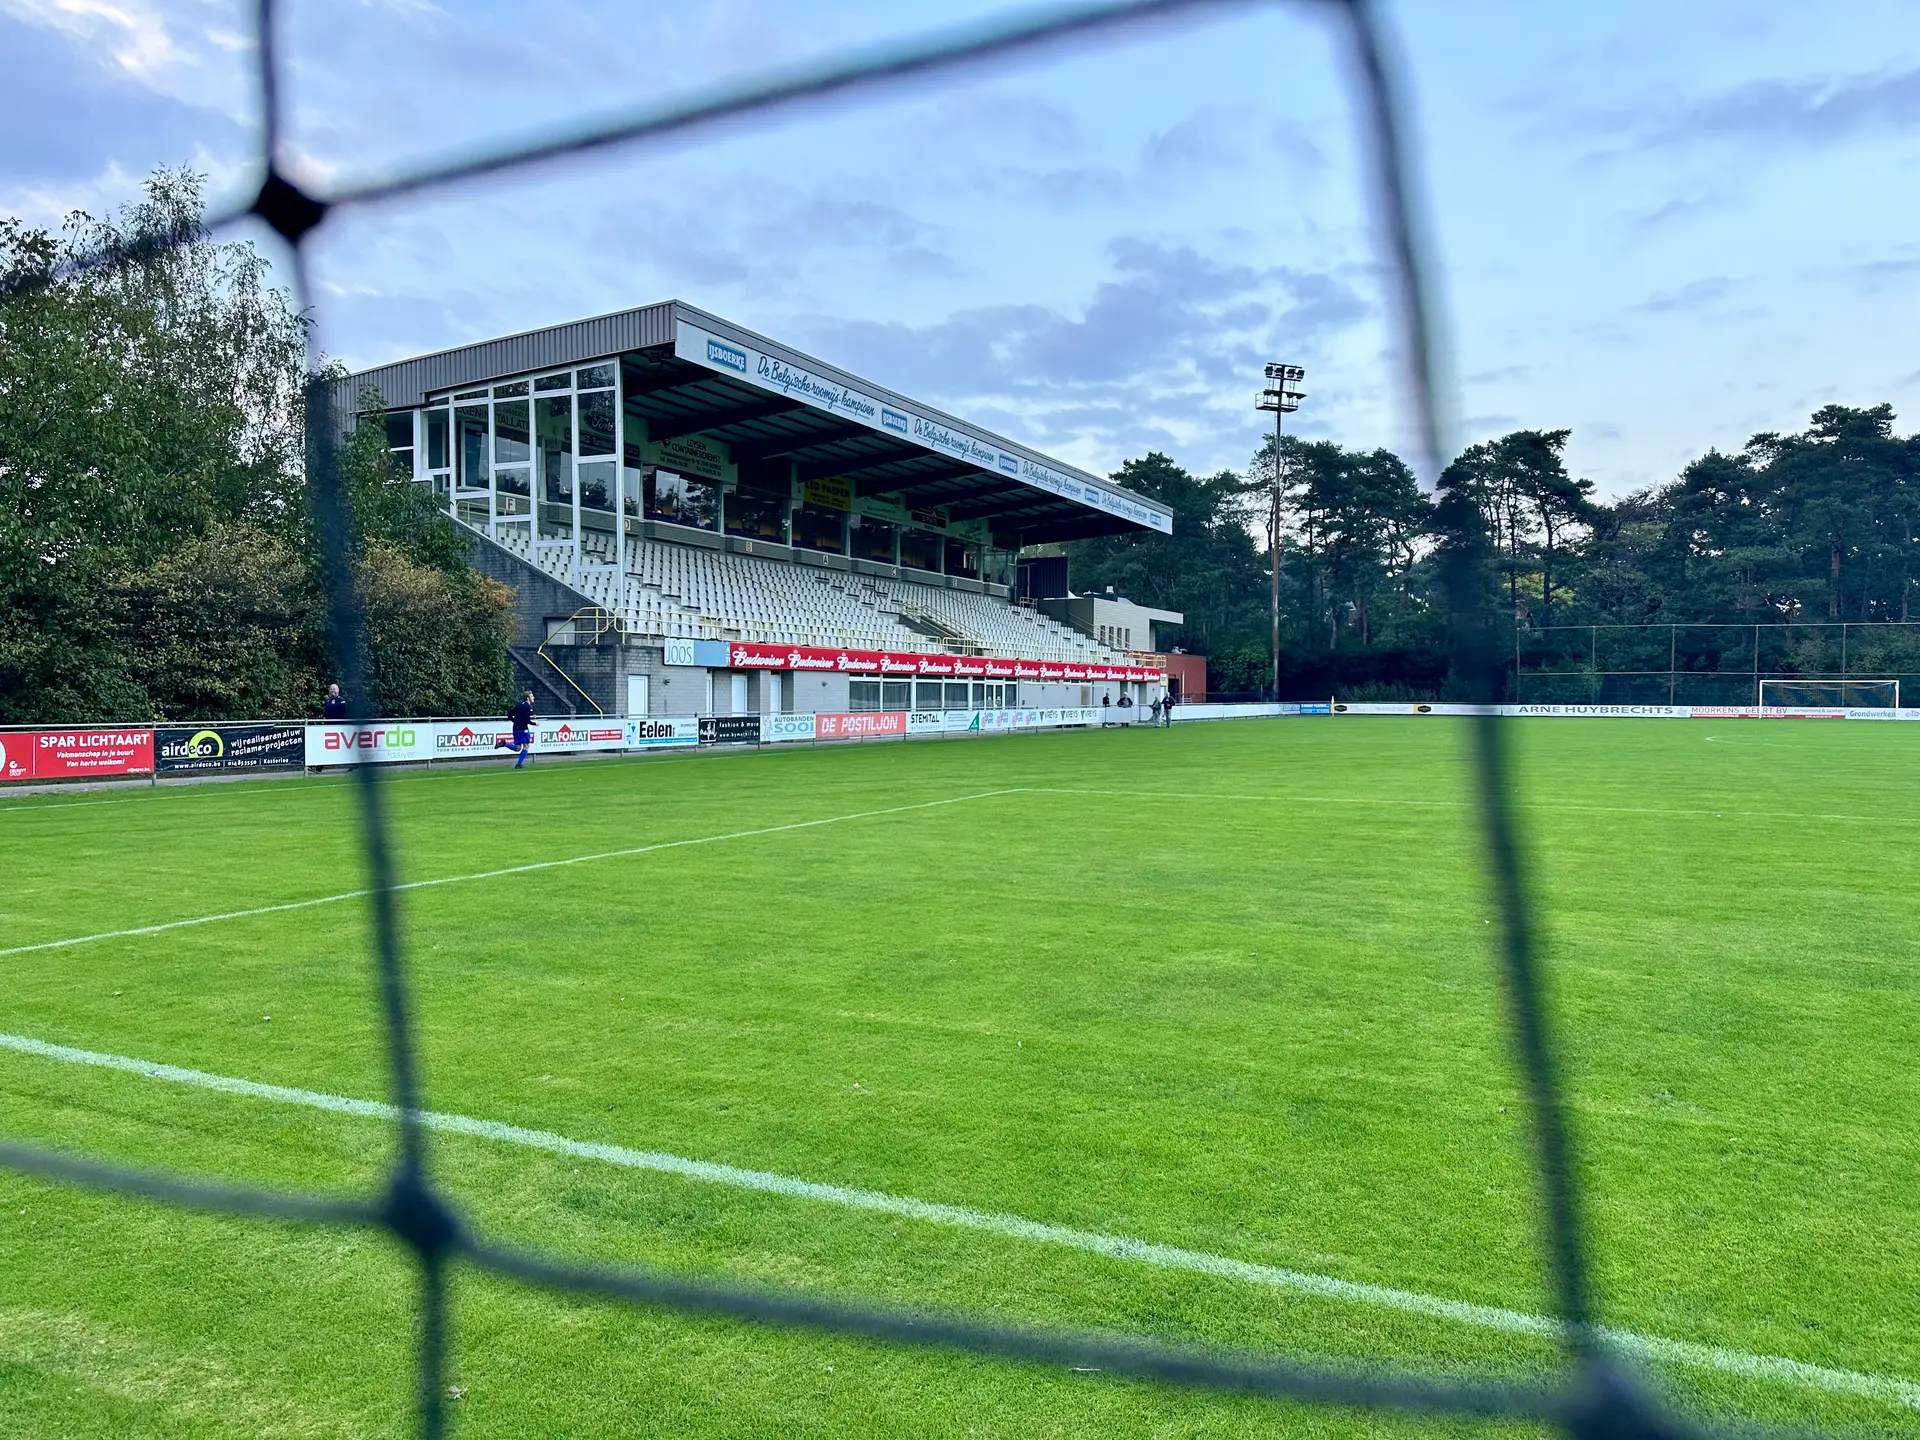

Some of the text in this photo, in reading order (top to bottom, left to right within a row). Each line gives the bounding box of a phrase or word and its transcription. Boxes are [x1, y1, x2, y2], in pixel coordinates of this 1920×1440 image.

[709, 345, 745, 371] IJSBOERKE
[757, 356, 770, 378] De
[770, 361, 811, 393] Belgische
[914, 418, 923, 435] De
[666, 646, 692, 664] JOOS
[732, 651, 785, 667] Budweiser
[788, 653, 834, 669] Budweiser
[1565, 706, 1674, 714] HUYBRECHTS
[1691, 706, 1740, 714] MOORKENS
[1850, 710, 1896, 718] Grondwerken
[639, 721, 672, 739] Eelen
[775, 722, 814, 733] SOOI
[821, 715, 898, 733] DE POSTILJON
[40, 733, 150, 749] SPAR LICHTAART
[324, 725, 415, 750] averdo
[438, 734, 493, 747] PLAFOMAT
[541, 730, 588, 743] PLAFOMAT
[57, 750, 100, 759] Vakmanschap
[109, 749, 117, 759] je
[117, 748, 134, 757] buurt
[162, 741, 212, 757] airdeco
[80, 759, 97, 767] harte
